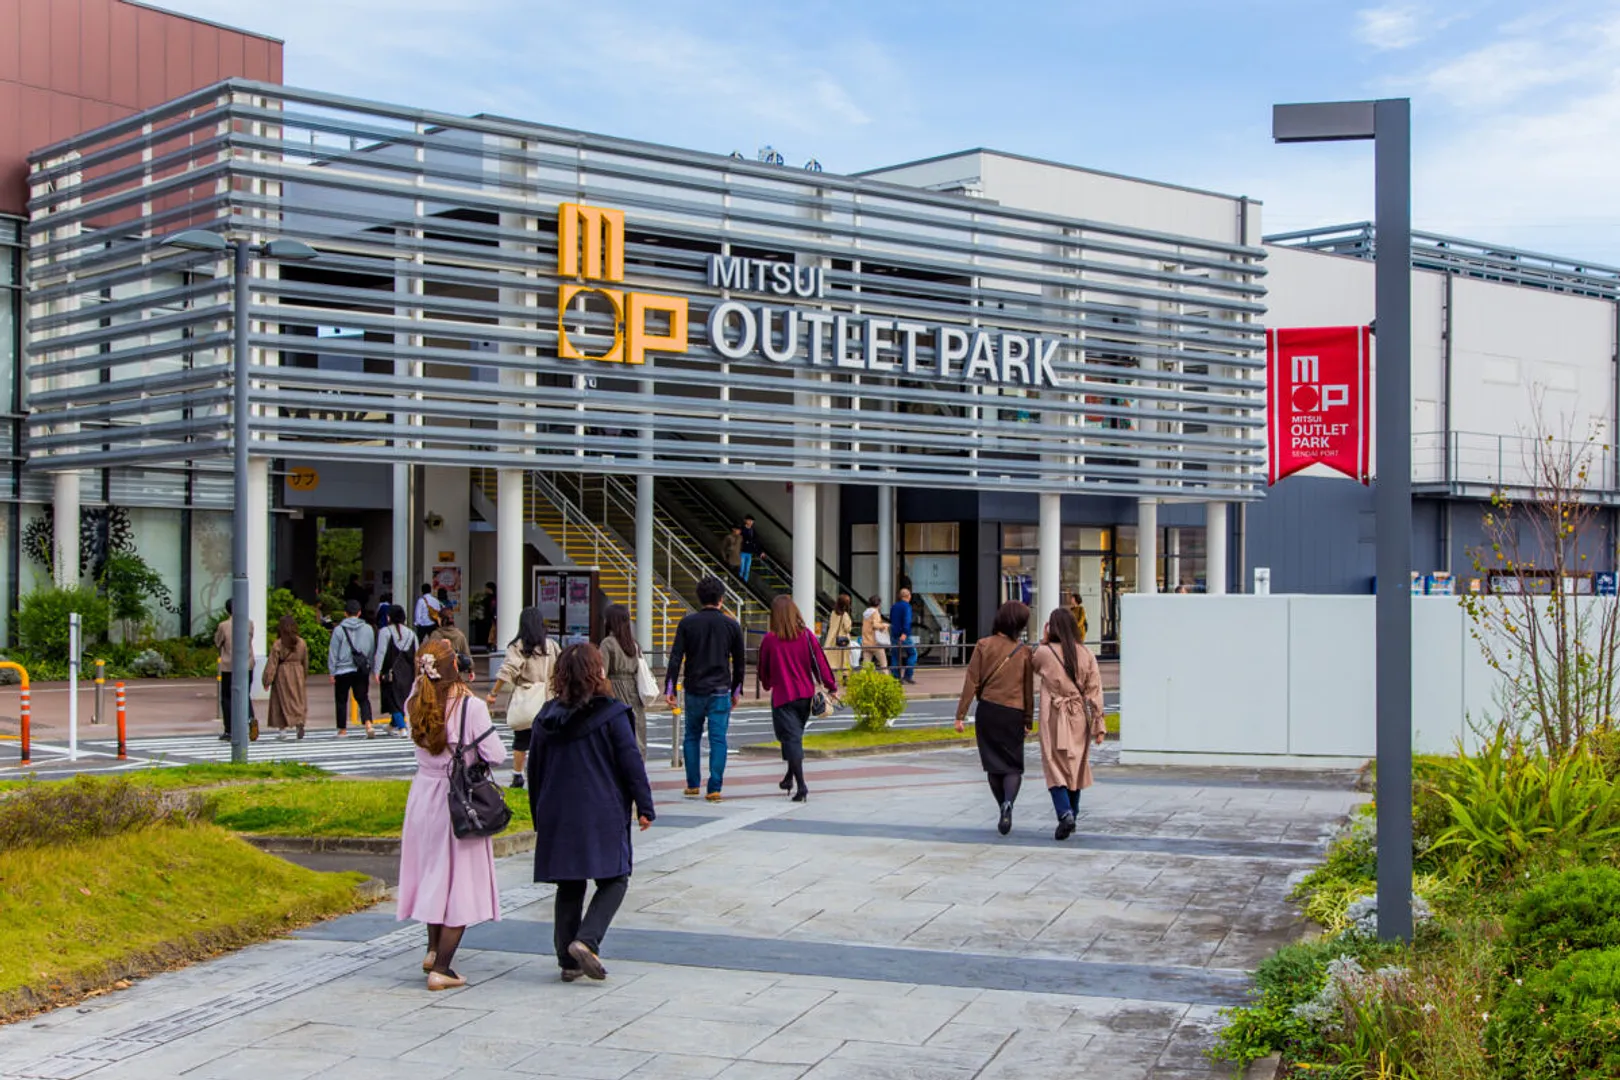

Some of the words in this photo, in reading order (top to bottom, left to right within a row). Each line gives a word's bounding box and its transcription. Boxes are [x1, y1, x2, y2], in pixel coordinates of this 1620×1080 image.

[707, 253, 824, 298] MITSUI
[708, 300, 928, 373] OUTLET
[936, 326, 1061, 387] PARK
[1292, 415, 1322, 423] MITSUI
[1291, 424, 1349, 436] OUTLET
[1292, 437, 1330, 448] PARK
